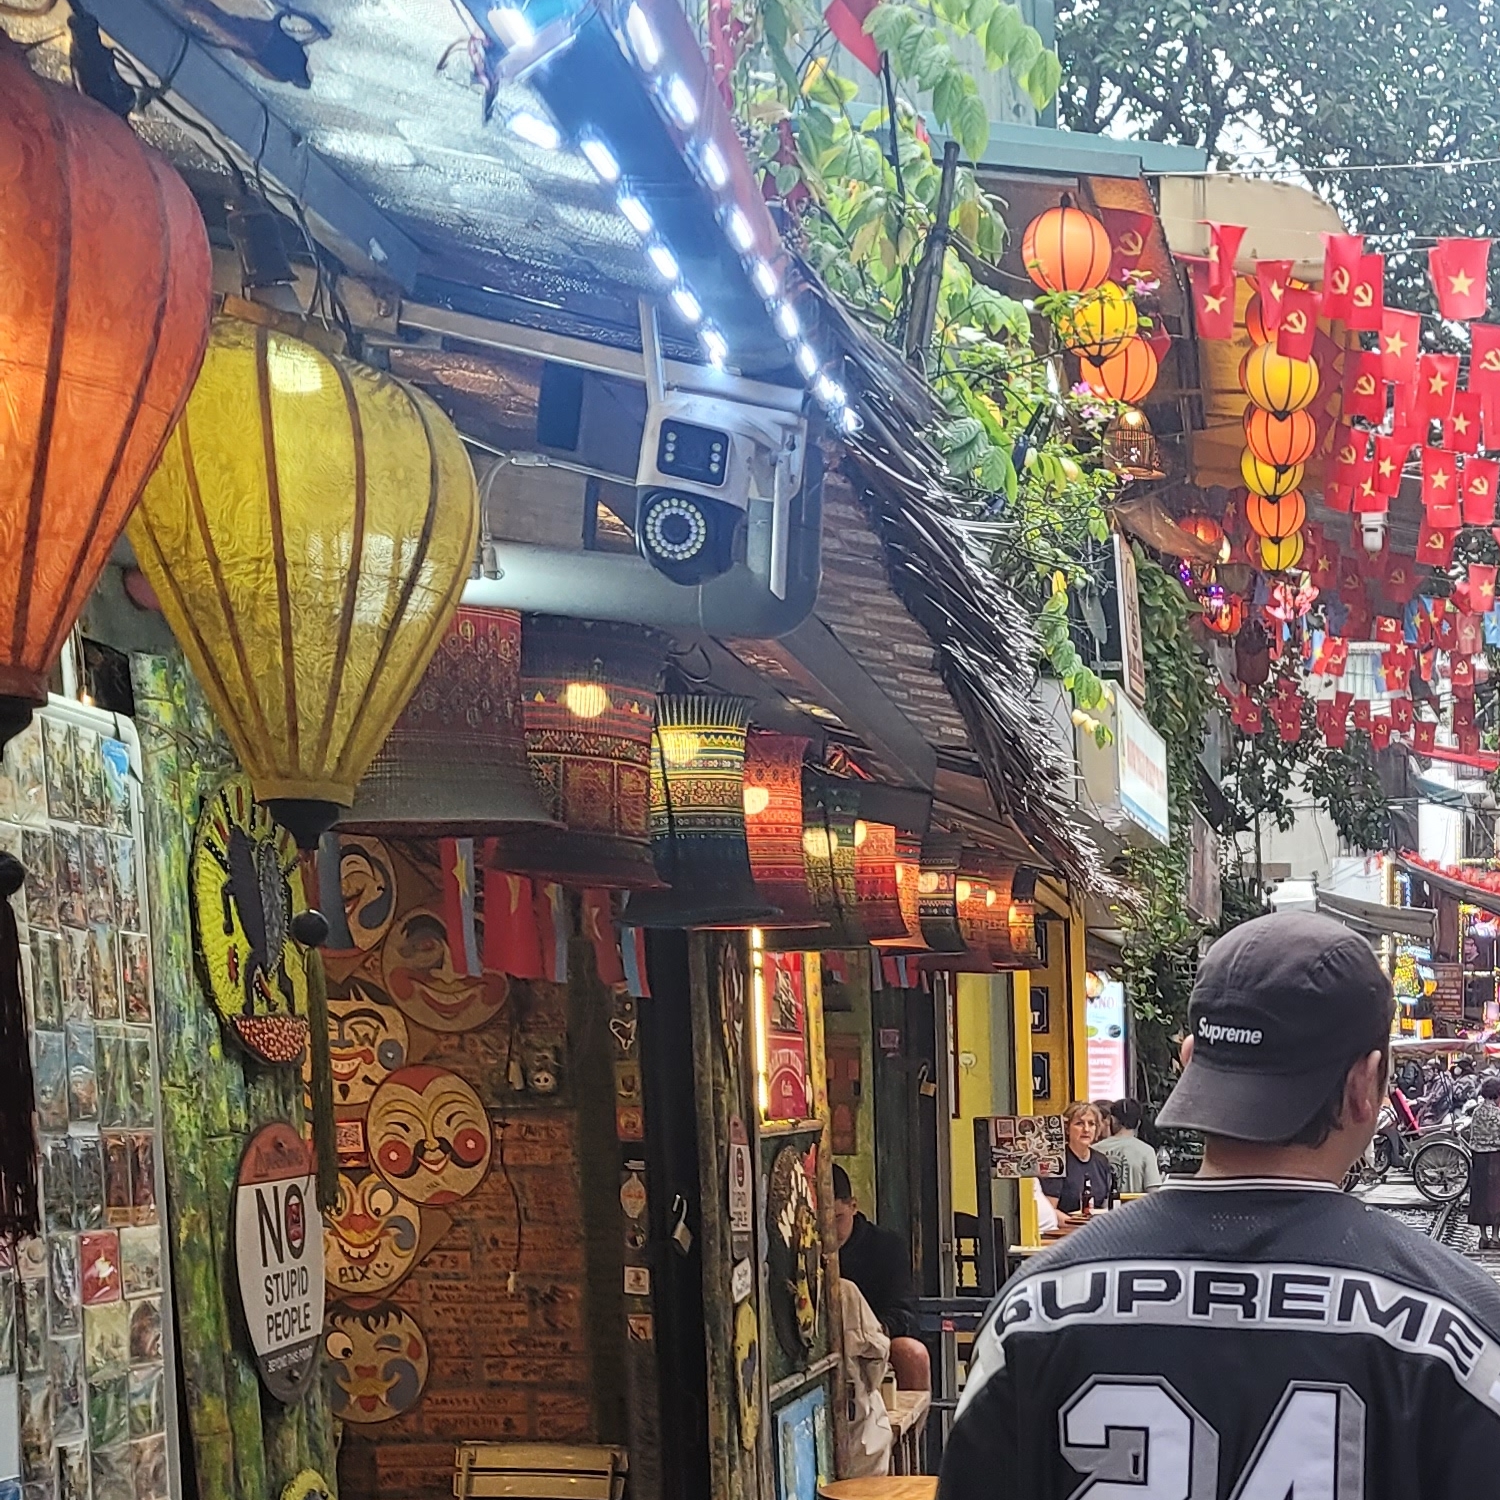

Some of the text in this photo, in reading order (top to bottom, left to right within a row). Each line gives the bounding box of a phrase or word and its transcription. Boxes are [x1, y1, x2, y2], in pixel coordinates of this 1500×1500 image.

[1198, 1016, 1263, 1045] Supreme
[255, 1183, 307, 1267] NO
[264, 1265, 309, 1307] STUPID
[266, 1302, 312, 1345] PEOPLE
[993, 1268, 1486, 1378] SUPREME
